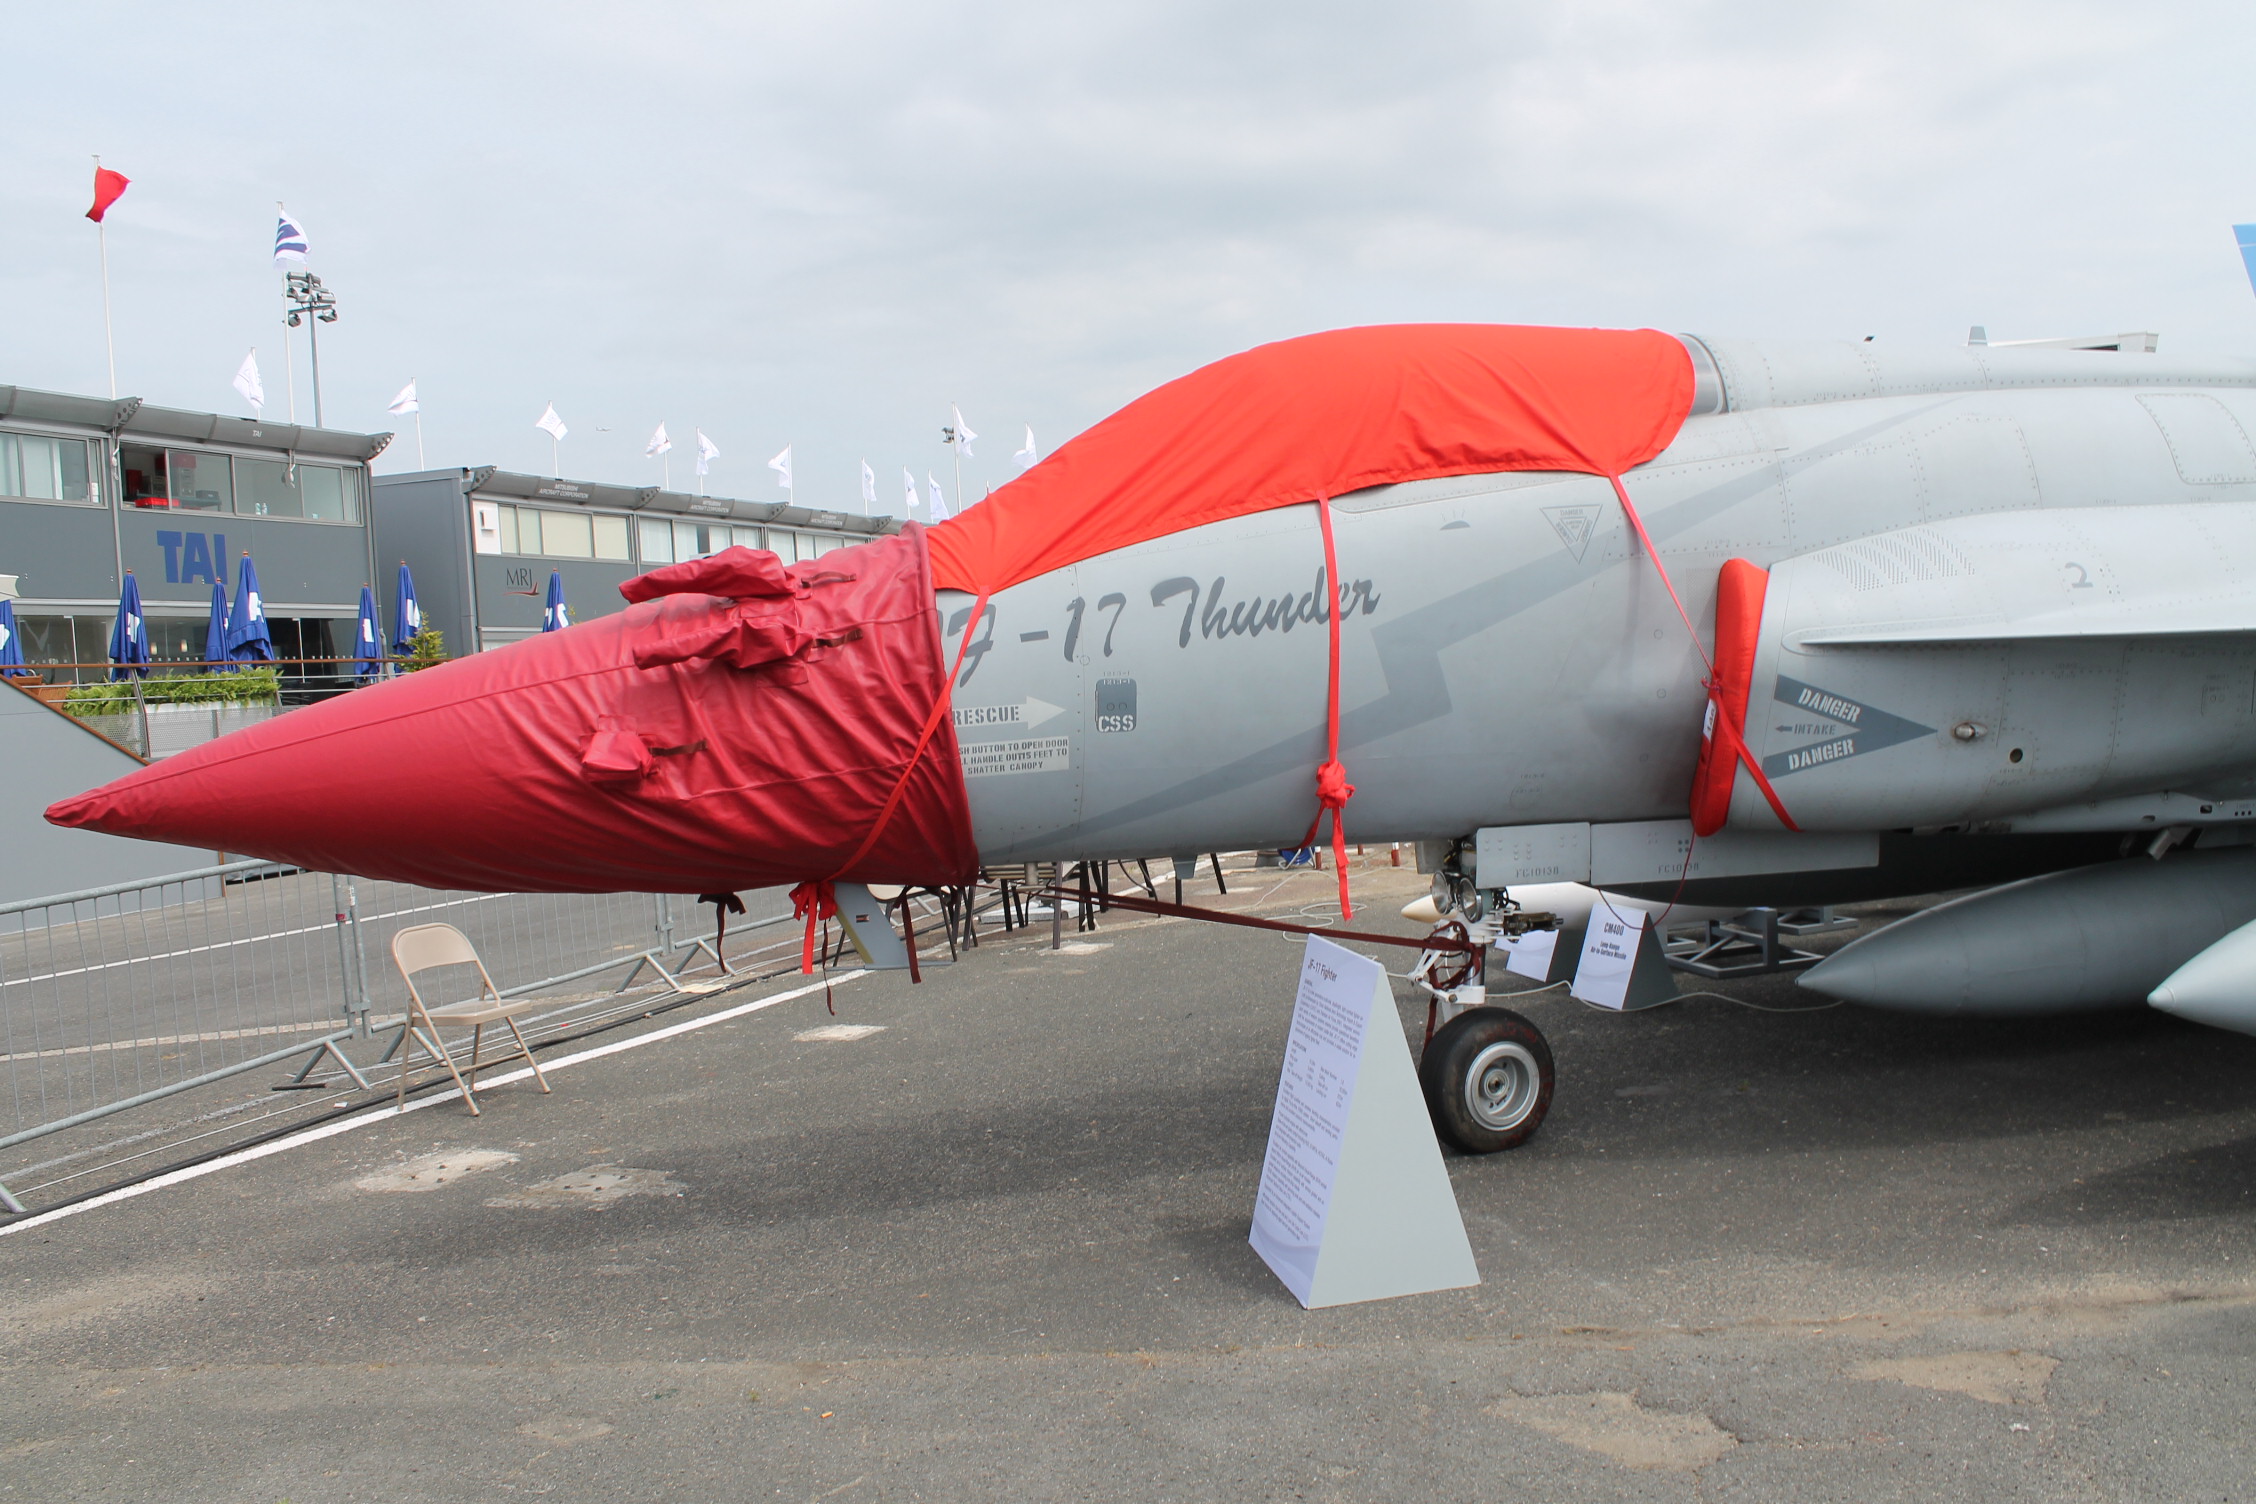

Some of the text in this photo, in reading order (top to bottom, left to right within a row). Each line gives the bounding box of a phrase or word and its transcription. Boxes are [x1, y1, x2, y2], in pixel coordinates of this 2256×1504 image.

[156, 530, 228, 585] TAI
[506, 567, 532, 588] MRJ
[2064, 562, 2093, 588] 2
[937, 566, 1381, 688] F-17 Thunder
[1798, 688, 1861, 723] DANGER
[953, 705, 1020, 726] RESCUE
[1098, 714, 1134, 732] CSS
[1794, 724, 1837, 735] INTAKE
[972, 744, 1006, 754] BUTTON
[1008, 743, 1019, 751] TO
[1021, 741, 1043, 750] OPEN
[1045, 739, 1068, 748] DOOR
[1788, 738, 1854, 770] DANGER
[971, 754, 1004, 765] HANDLE
[1034, 749, 1053, 759] FEET
[1056, 748, 1067, 757] TO
[968, 761, 1043, 775] SHATTER CANOPY
[1603, 922, 1625, 936] CM400
[1321, 965, 1338, 982] Fighter
